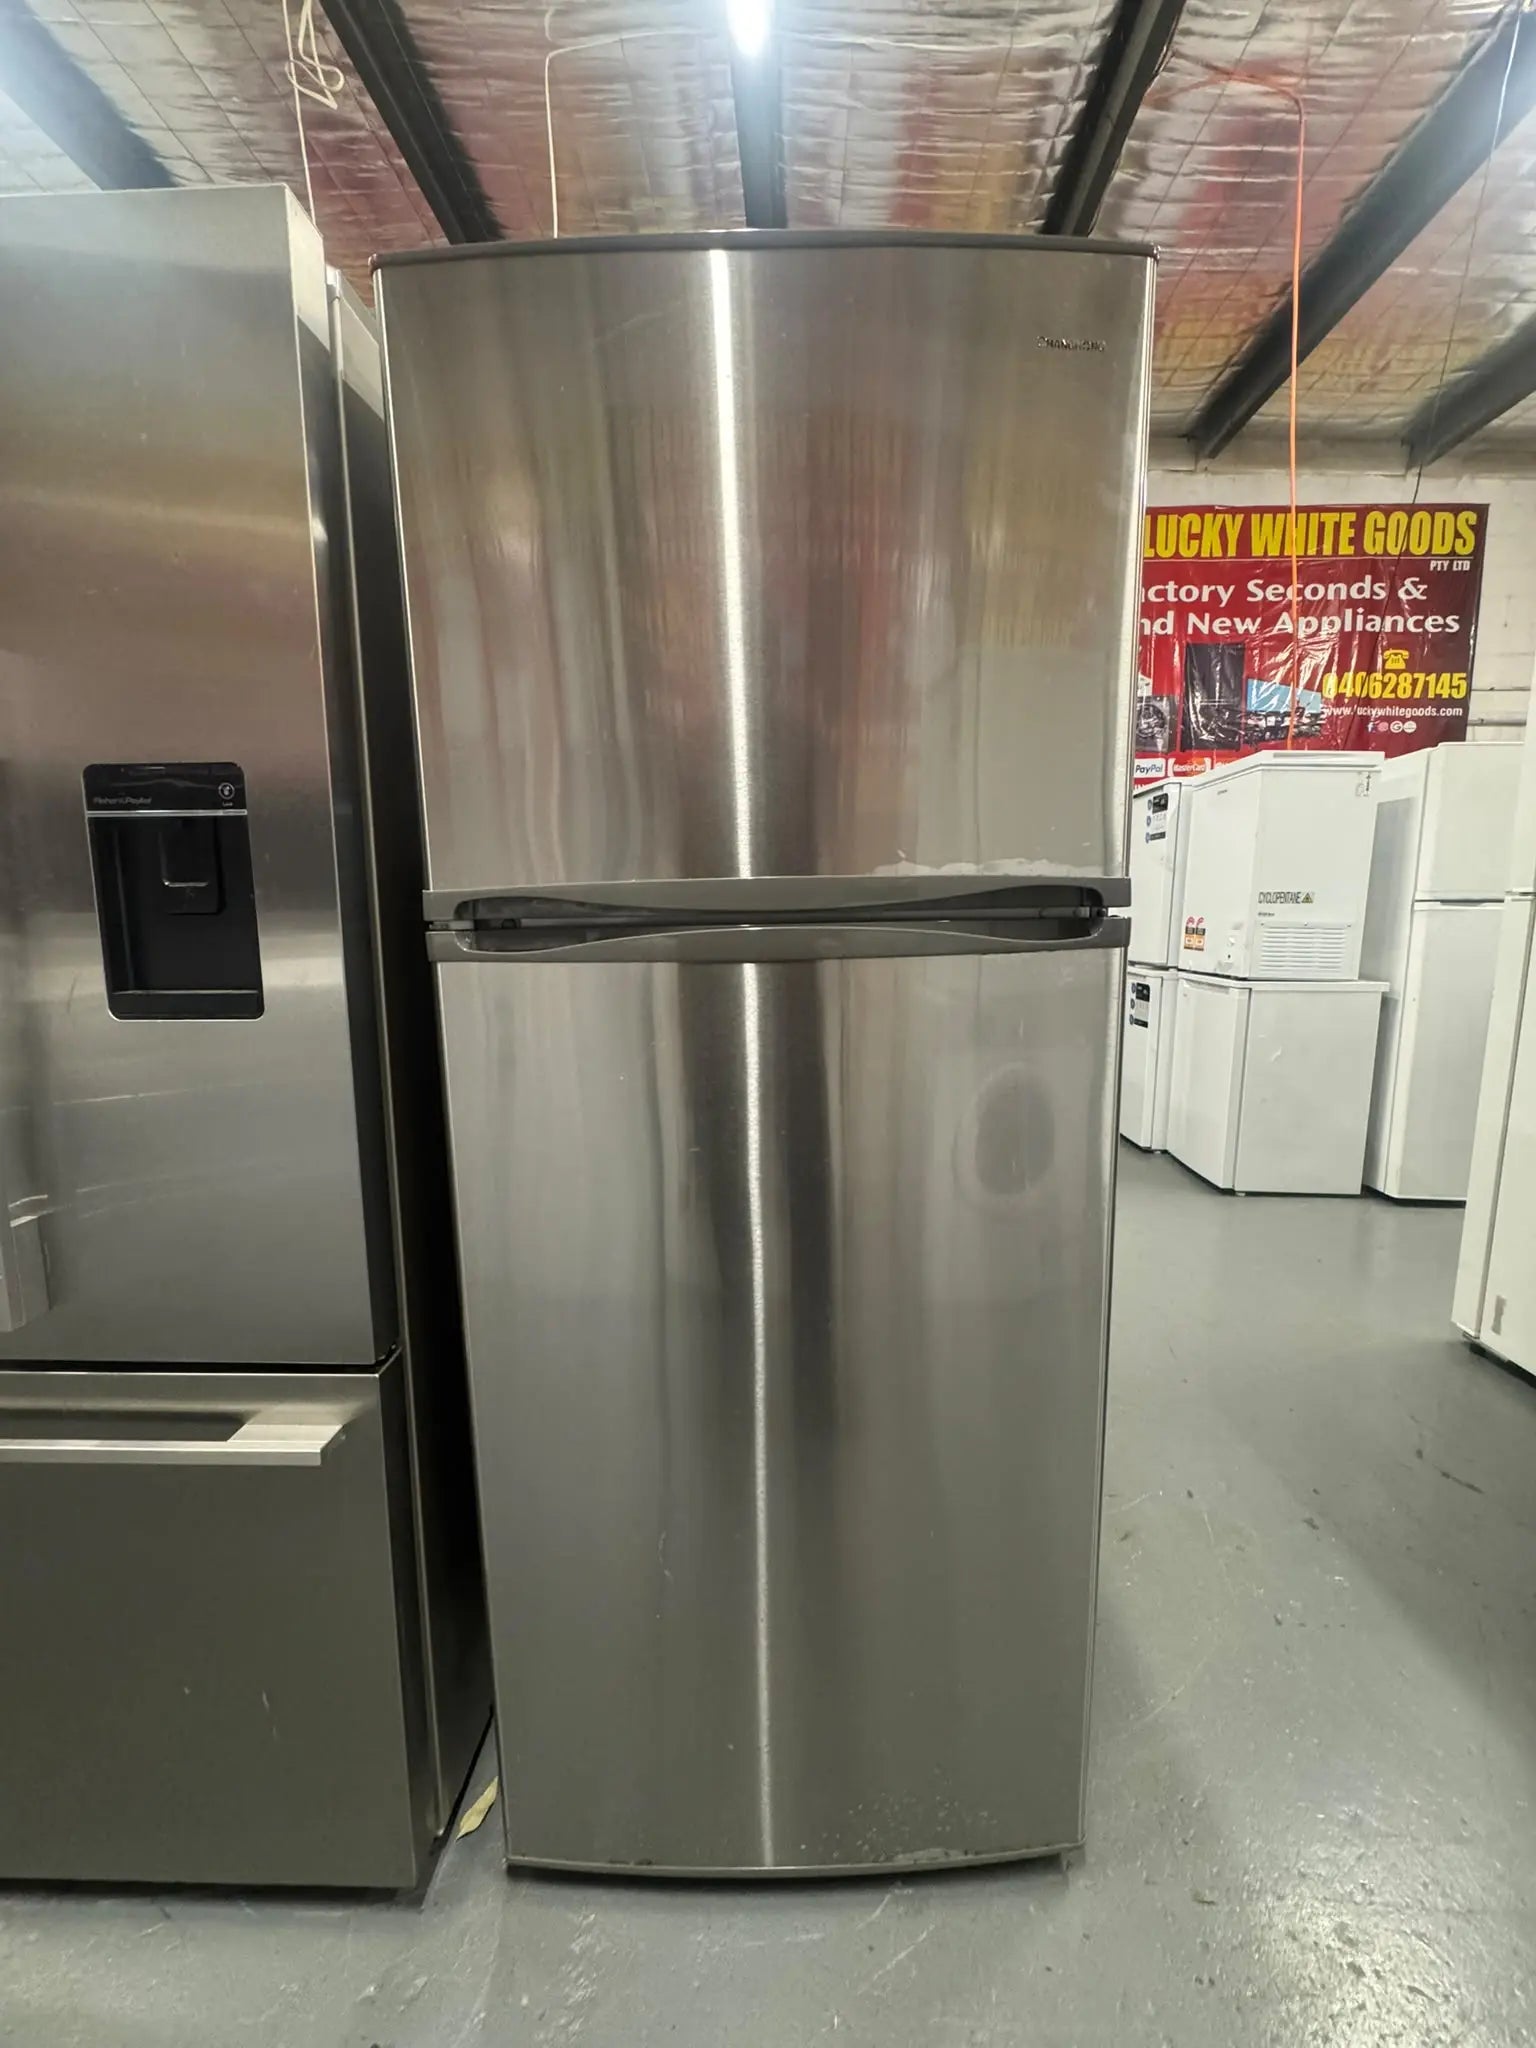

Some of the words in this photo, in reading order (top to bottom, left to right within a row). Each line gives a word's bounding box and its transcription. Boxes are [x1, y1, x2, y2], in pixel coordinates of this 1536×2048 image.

[1143, 513, 1244, 558] LUCKY
[1251, 512, 1356, 557] WHITE
[1363, 511, 1477, 556] GOODS
[1430, 560, 1449, 572] PTY
[1452, 560, 1471, 571] LTD
[1246, 575, 1387, 603] Seconds
[1397, 577, 1428, 601] &
[1187, 612, 1262, 636] New
[1271, 607, 1460, 640] Appliances
[1322, 671, 1468, 699] 0406287145
[1135, 763, 1163, 775] PayPal
[1258, 891, 1302, 905] CYCLOPENTANE
